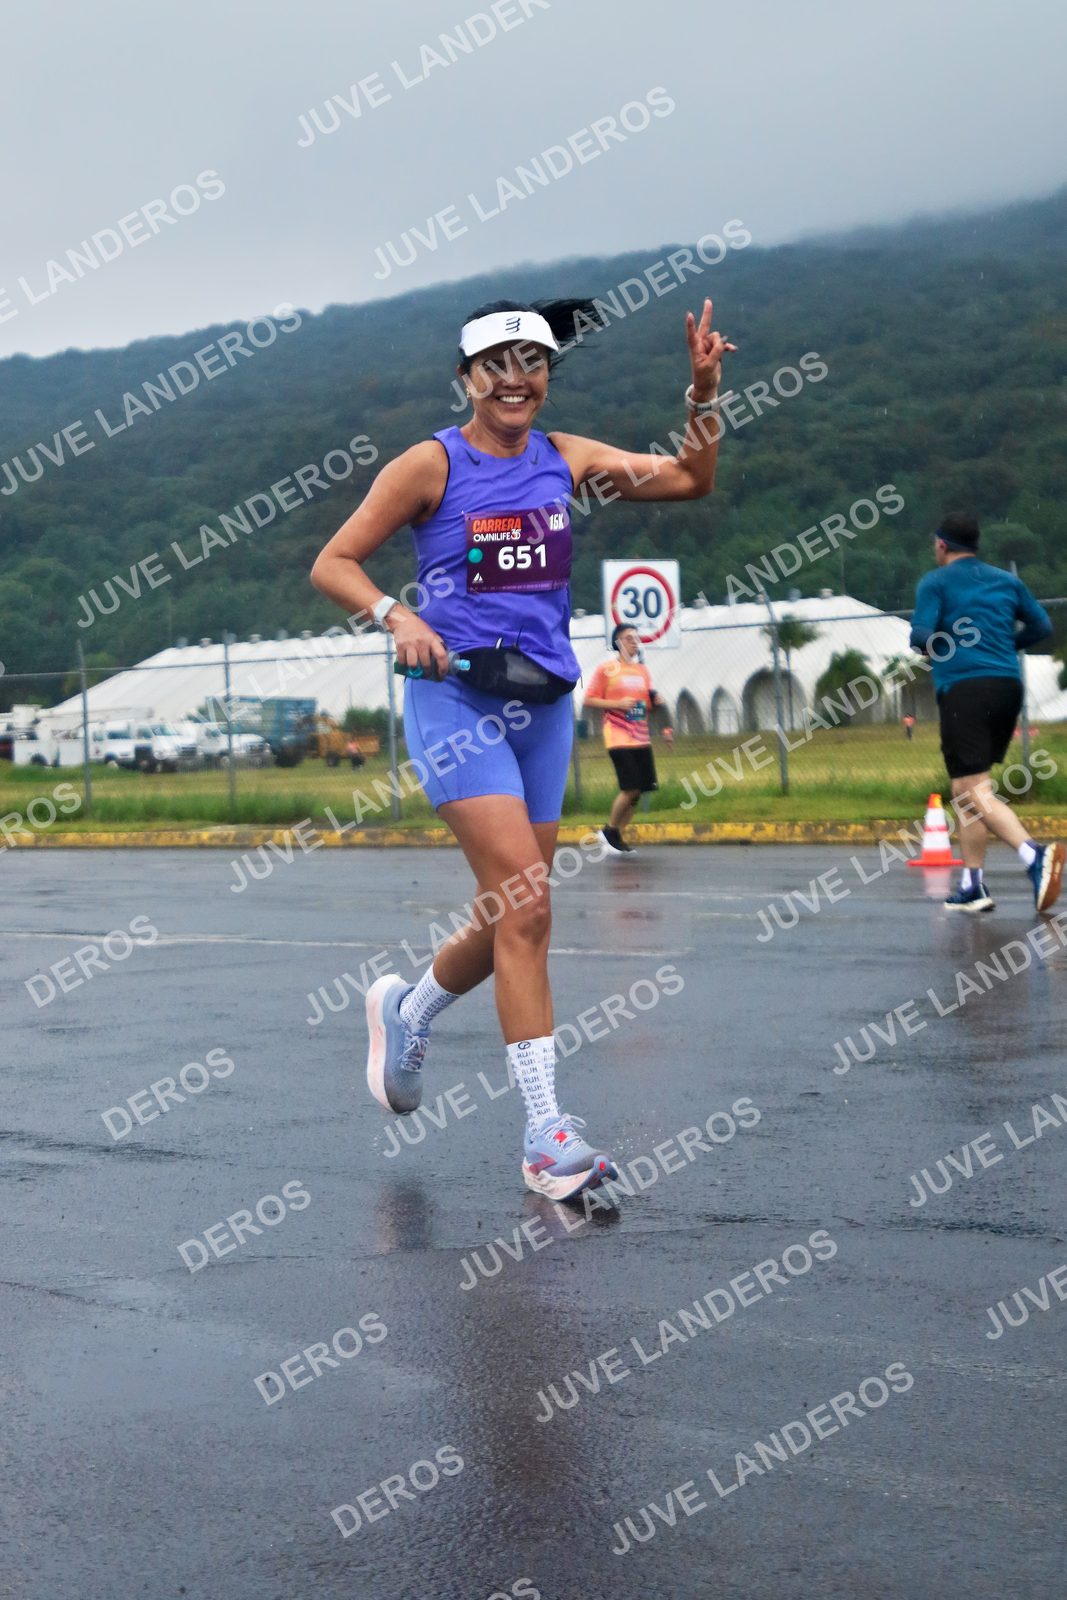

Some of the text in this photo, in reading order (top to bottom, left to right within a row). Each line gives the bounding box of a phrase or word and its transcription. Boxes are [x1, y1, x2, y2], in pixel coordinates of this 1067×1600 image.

[473, 517, 522, 533] CARRERA
[473, 531, 511, 542] OMNILIFE
[498, 544, 547, 570] 651
[622, 586, 662, 618] 30
